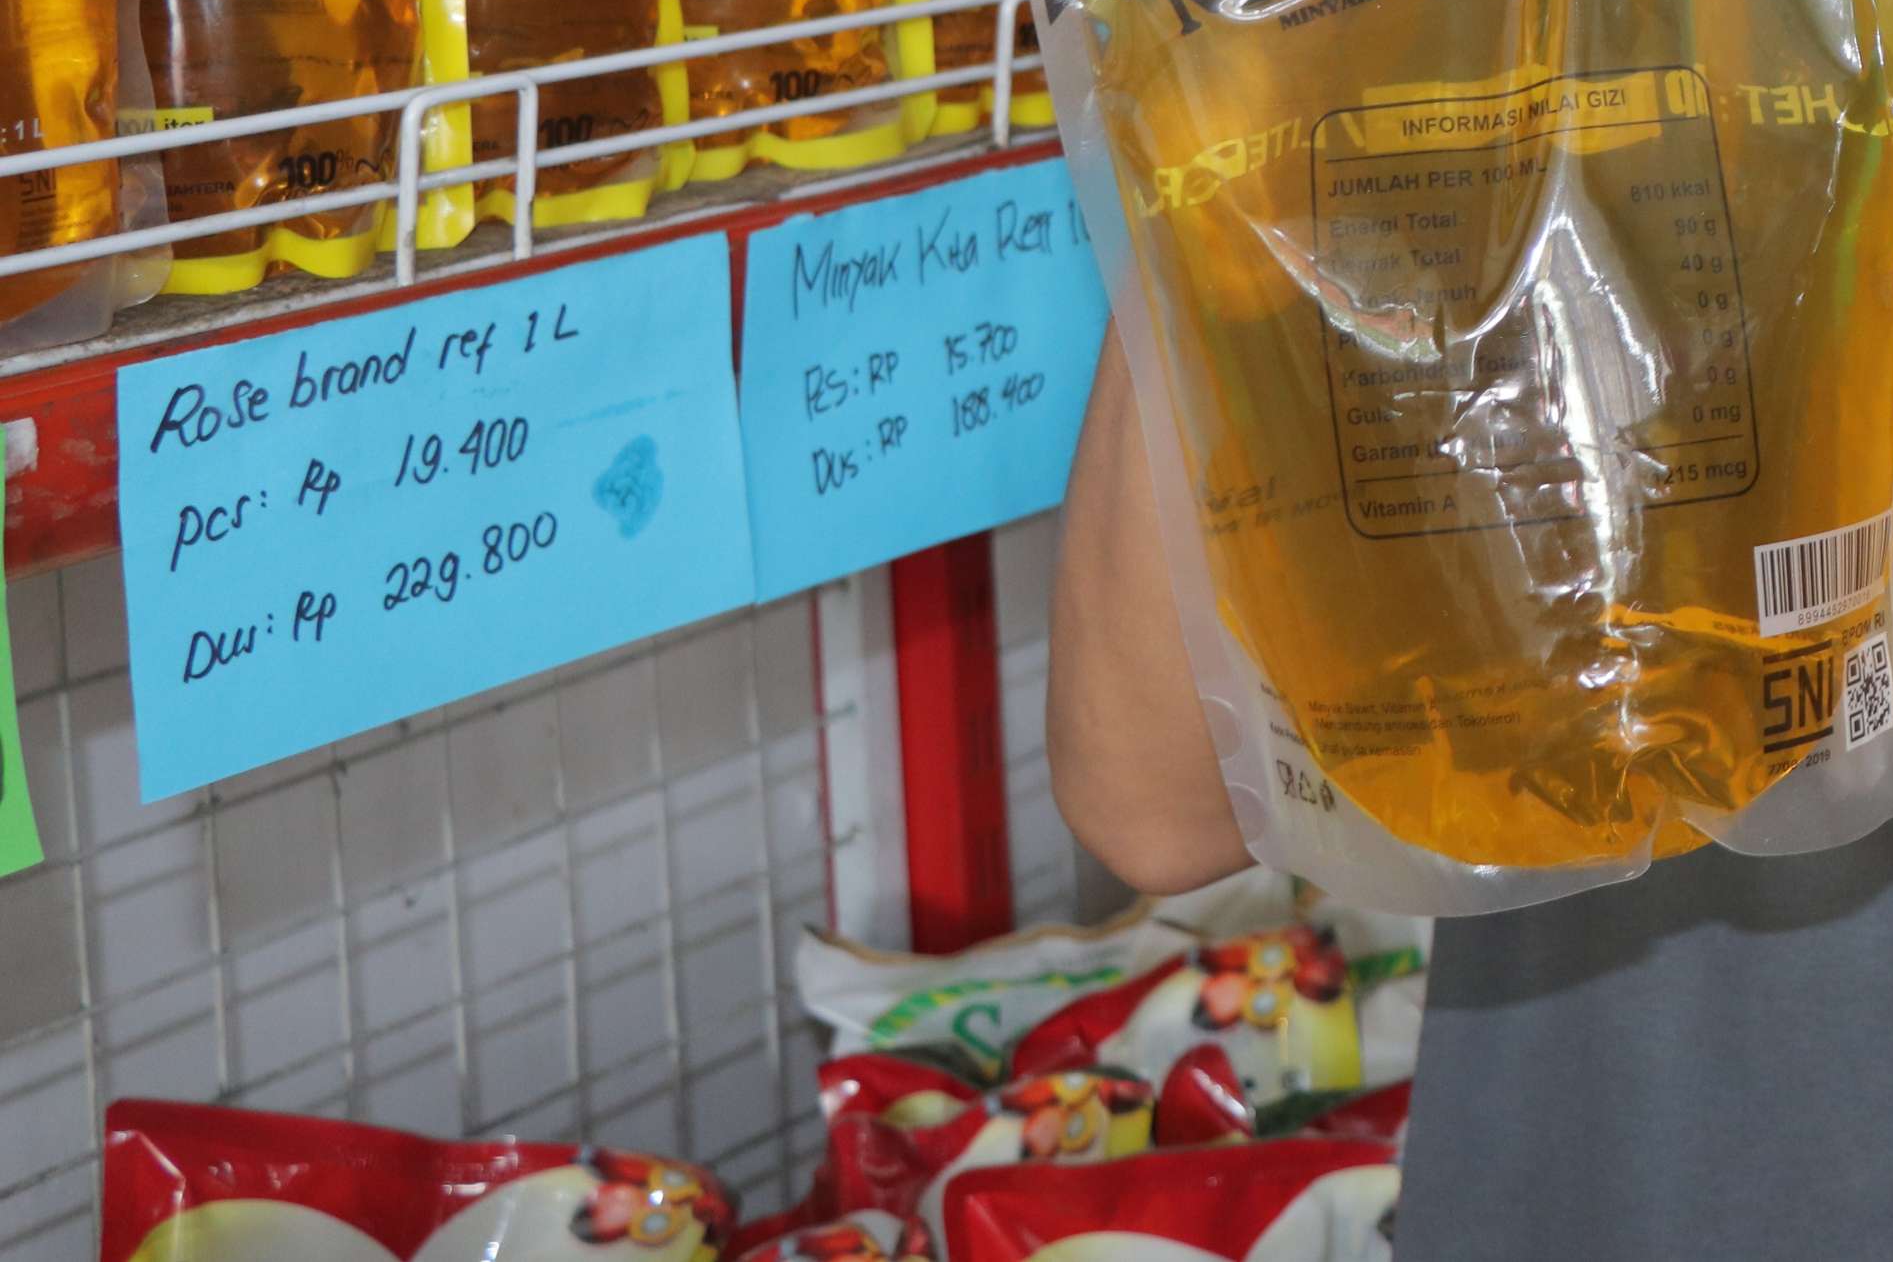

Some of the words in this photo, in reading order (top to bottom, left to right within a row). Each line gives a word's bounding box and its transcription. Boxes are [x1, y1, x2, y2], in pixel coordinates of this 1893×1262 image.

[1402, 105, 1523, 138] INFORMASI
[1527, 90, 1581, 122] NILAI
[1586, 86, 1627, 110] GIZI
[1328, 174, 1420, 198] JUMLAH
[1428, 169, 1474, 188] PER
[1481, 166, 1514, 185] 100
[1405, 210, 1458, 231] Total
[1671, 177, 1711, 199] kkal
[1410, 247, 1463, 268] Total
[1704, 217, 1717, 237] g
[1680, 253, 1704, 273] 40
[1710, 255, 1724, 274] g
[1715, 292, 1729, 311] g
[149, 379, 270, 454] Rose
[289, 325, 417, 410] brand
[439, 322, 496, 375] ref
[552, 303, 580, 342] L
[1352, 442, 1420, 463] Garam
[1692, 404, 1704, 424] 0
[1711, 403, 1741, 424] mg
[297, 457, 342, 516] Rp
[394, 416, 530, 488] 19.400
[1358, 498, 1435, 519] Vitamin
[1443, 496, 1458, 511] A
[1706, 460, 1747, 480] mcg
[293, 590, 338, 643] Rp
[383, 511, 558, 611] 229.800
[1762, 656, 1834, 738] SNI
